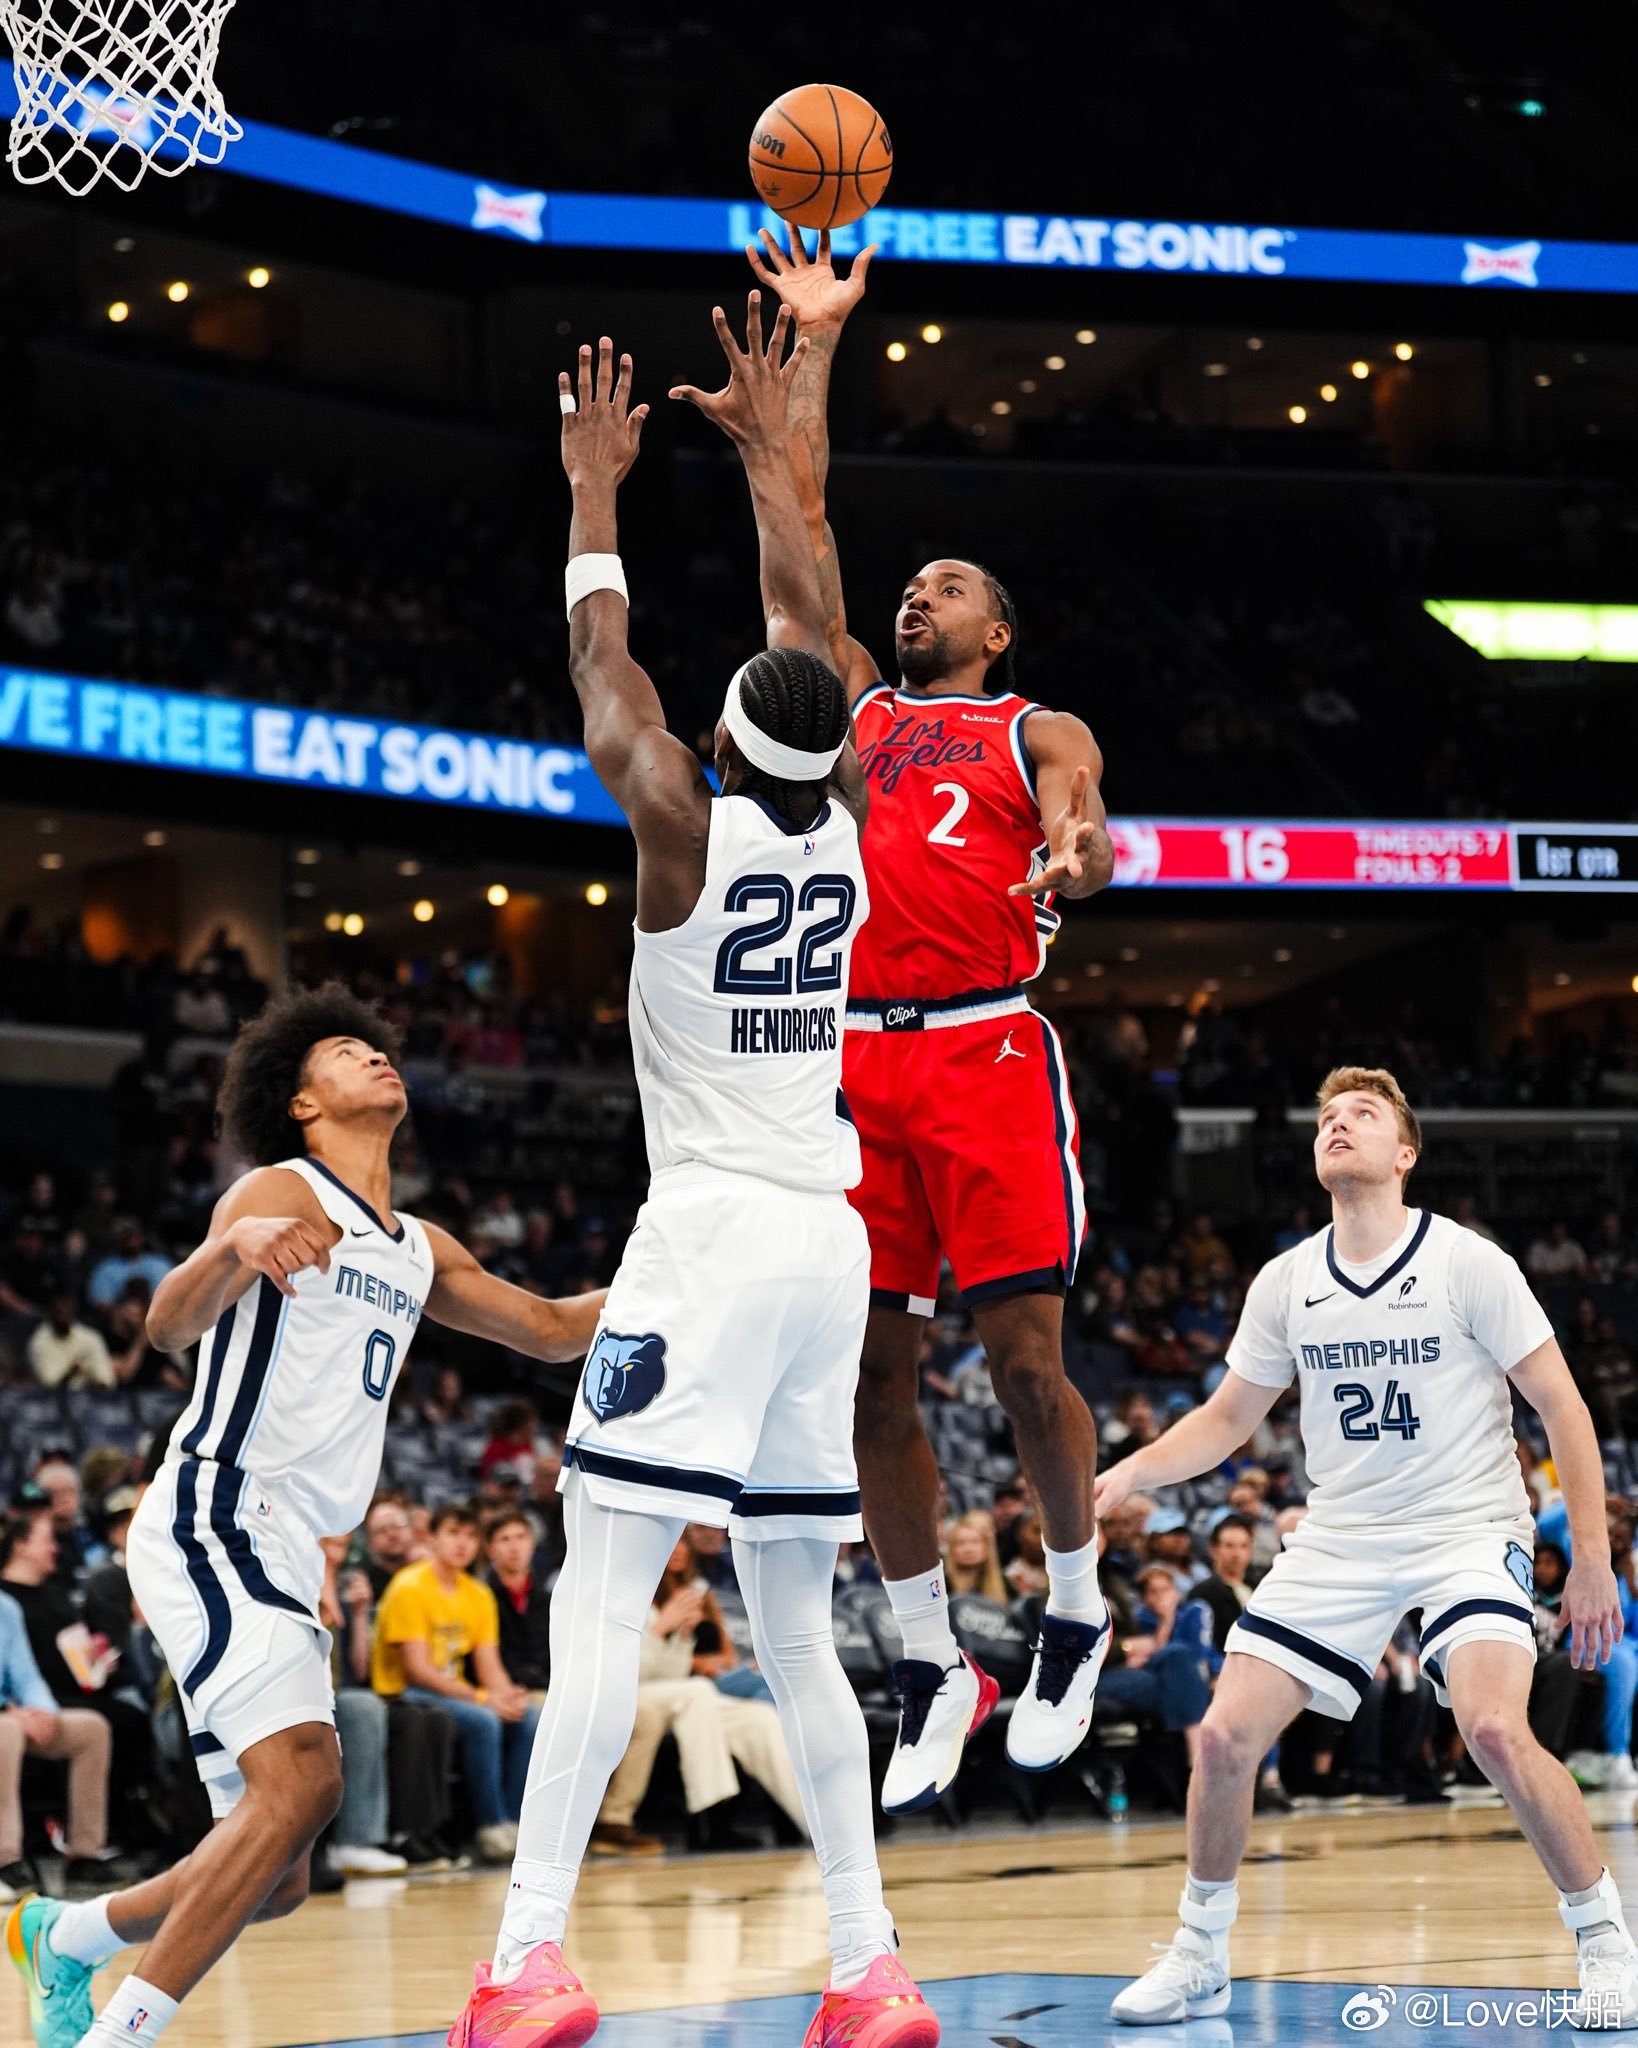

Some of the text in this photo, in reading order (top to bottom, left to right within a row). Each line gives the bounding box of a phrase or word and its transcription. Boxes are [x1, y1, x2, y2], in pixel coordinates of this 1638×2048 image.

[863, 208, 998, 261] FREE
[1003, 215, 1110, 266] EAT
[1112, 221, 1287, 275] SONIC
[81, 683, 245, 771] FREE
[252, 707, 377, 787] EAT
[380, 729, 576, 814] SONIC
[883, 715, 945, 747] Los
[858, 736, 987, 794] Angeles
[927, 782, 970, 847] 2
[1219, 827, 1289, 883] 16
[713, 873, 857, 995] 22
[730, 1006, 837, 1054] HENDRICKS
[886, 1005, 918, 1026] Clips
[1388, 1301, 1428, 1311] Robinhood
[362, 1328, 396, 1402] 0
[1300, 1336, 1441, 1371] MEMPHIS
[1333, 1380, 1421, 1441] 24
